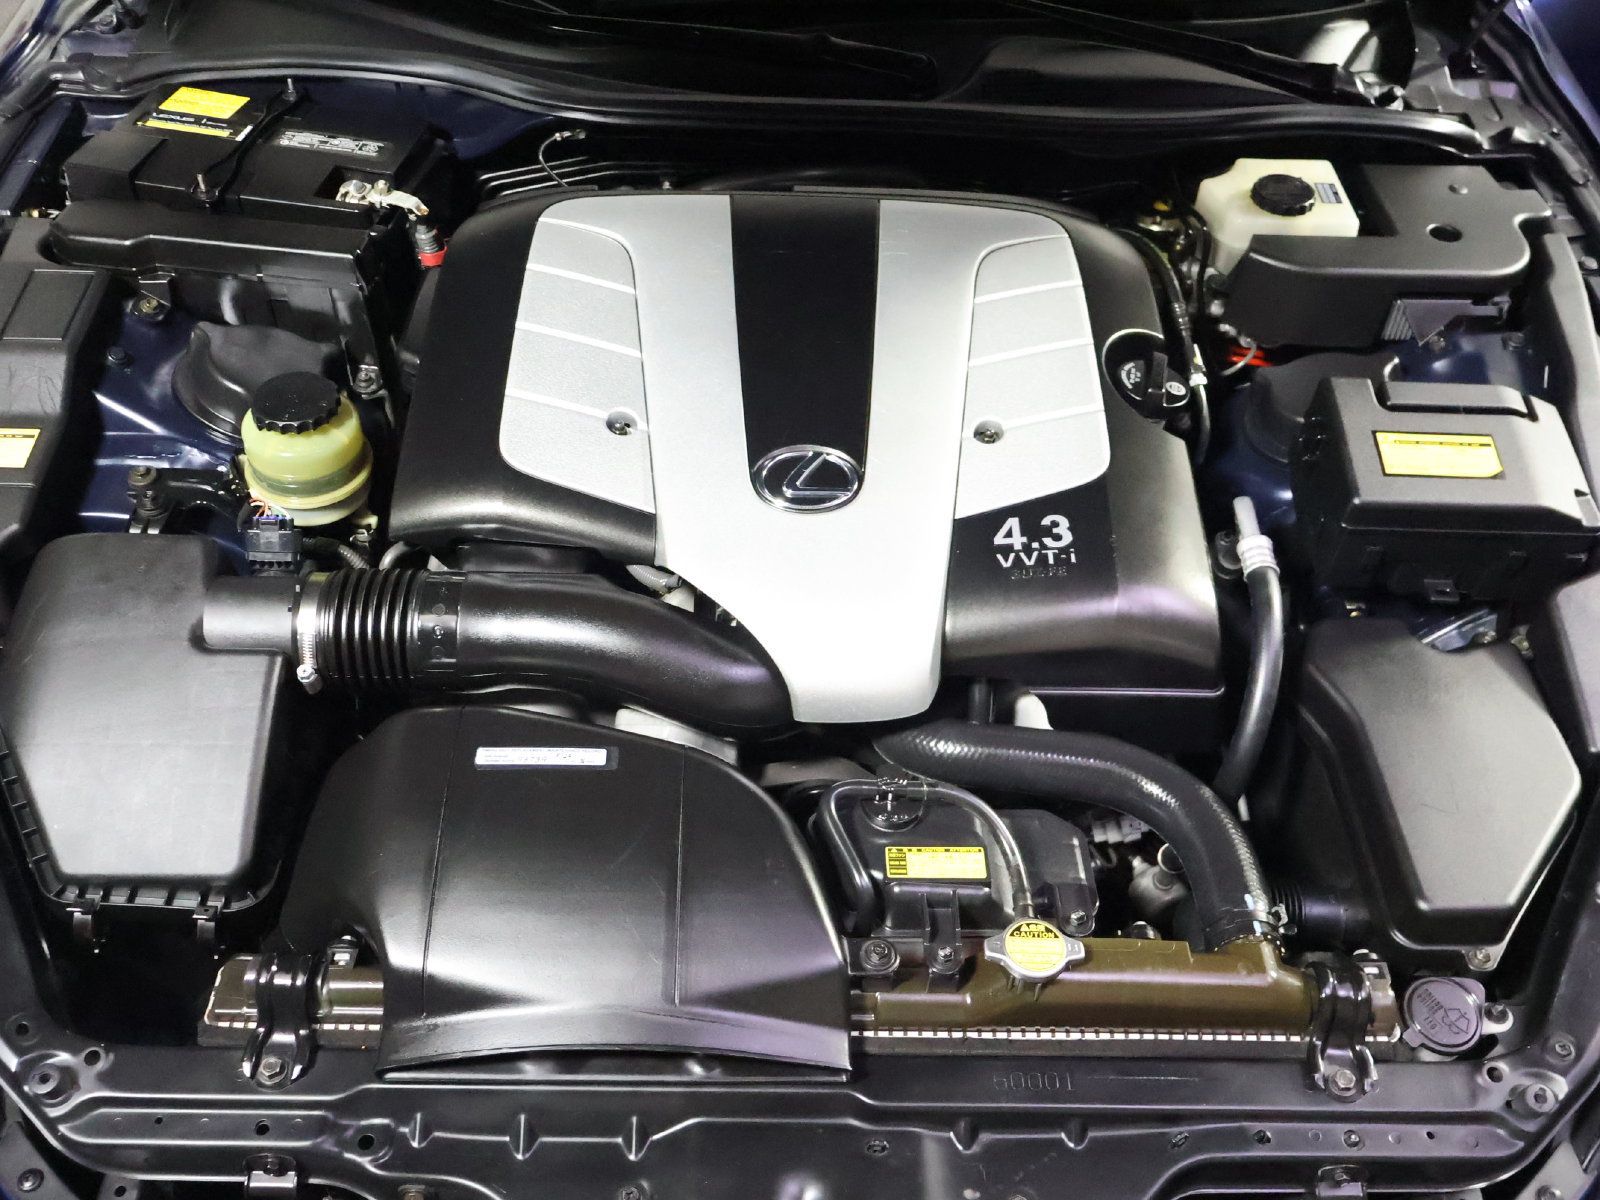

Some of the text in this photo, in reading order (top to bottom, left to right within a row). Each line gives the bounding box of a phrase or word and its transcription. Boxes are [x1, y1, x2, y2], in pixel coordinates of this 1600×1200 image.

[993, 514, 1074, 550] 4.3
[996, 548, 1076, 568] VVT-i
[1013, 930, 1055, 938] CAUTION
